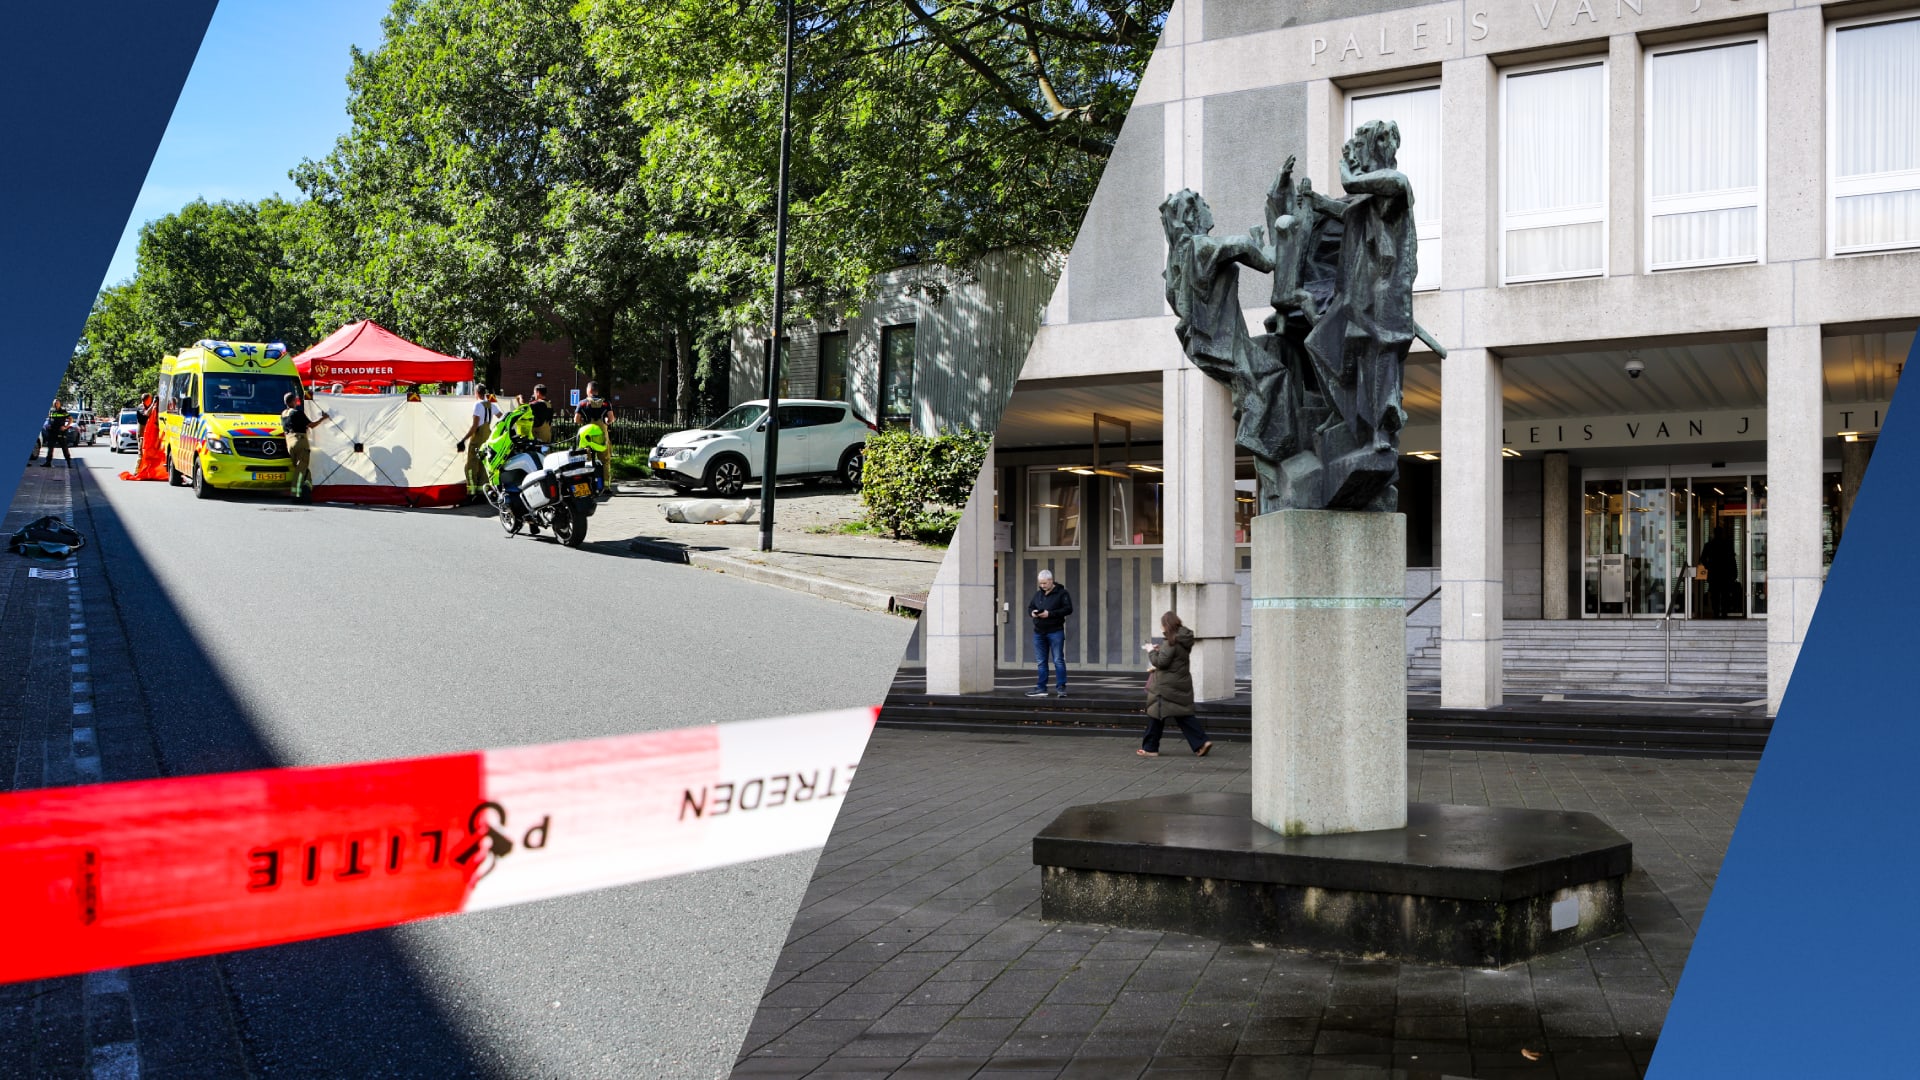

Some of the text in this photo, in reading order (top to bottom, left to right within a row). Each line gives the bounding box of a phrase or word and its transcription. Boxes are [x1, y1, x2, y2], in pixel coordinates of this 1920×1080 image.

[1311, 0, 1643, 66] PALEIS VAN
[331, 367, 393, 375] BRANDWEER
[1502, 424, 1593, 445] LEIS
[1626, 419, 1703, 439] VAN
